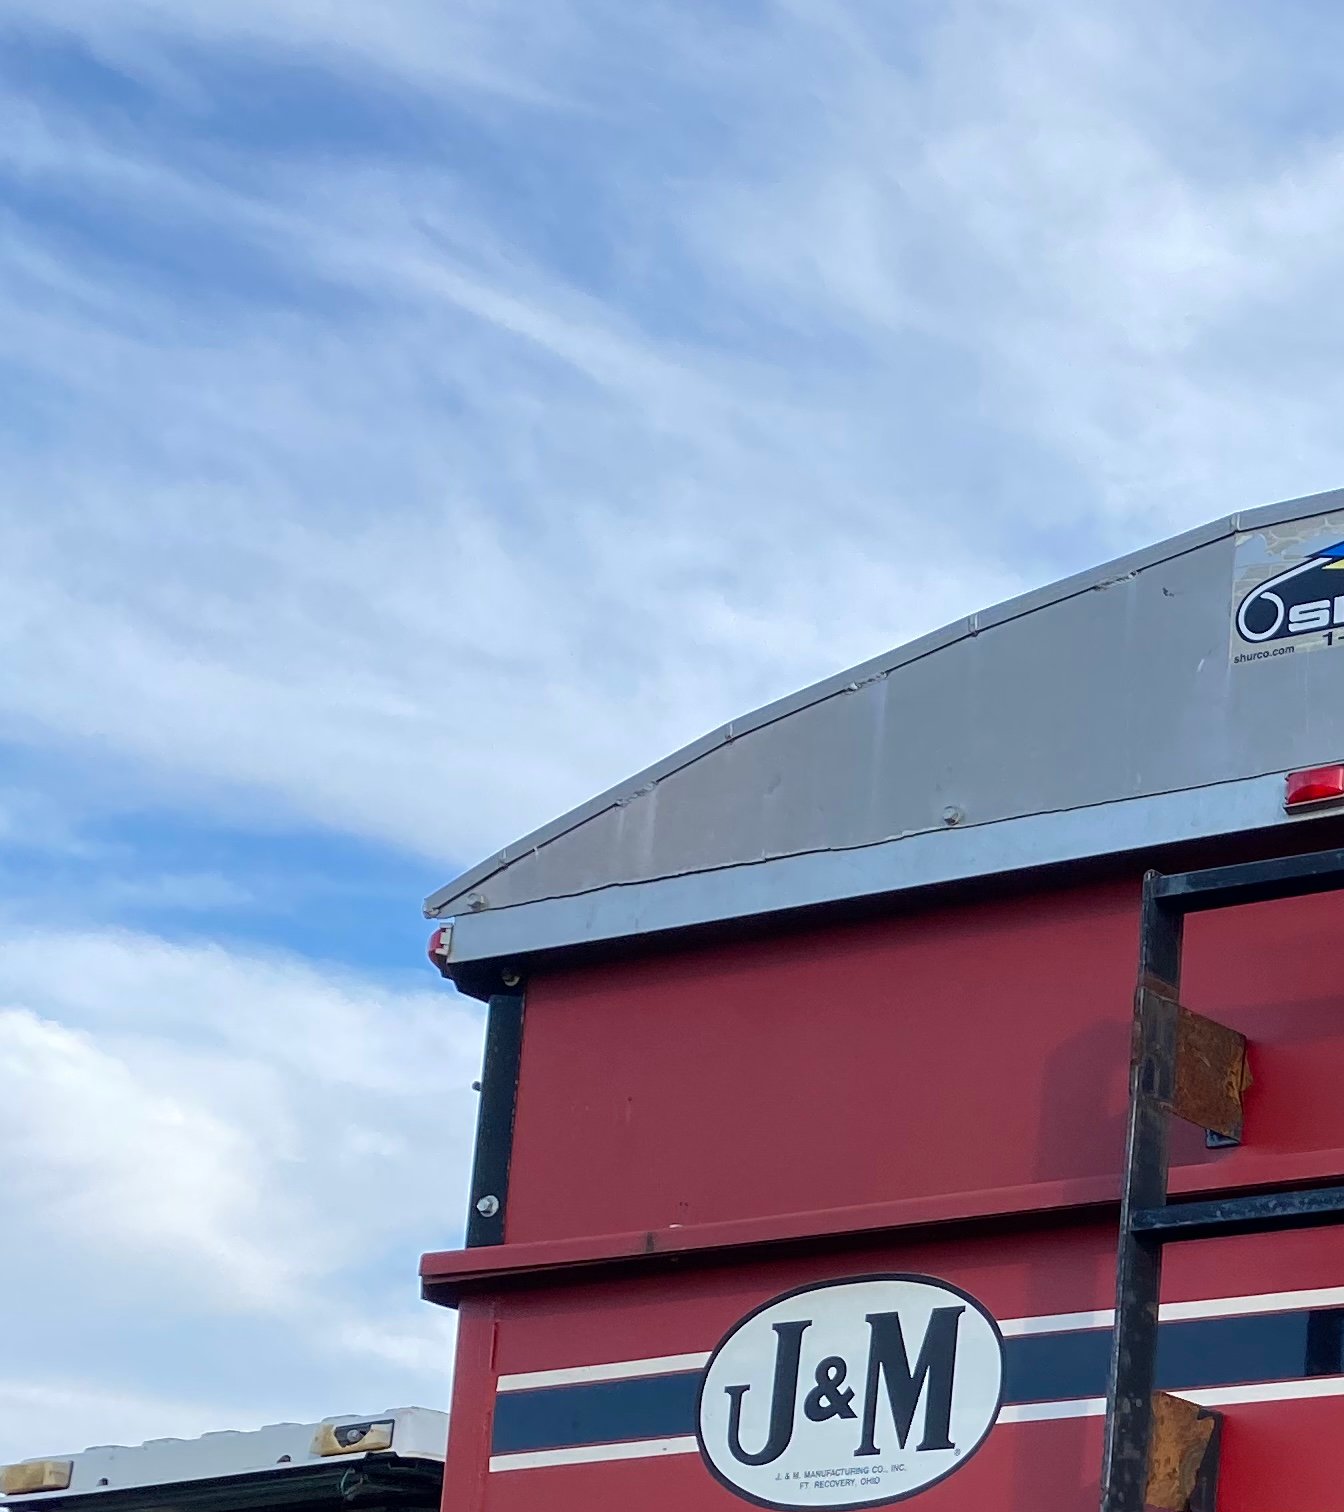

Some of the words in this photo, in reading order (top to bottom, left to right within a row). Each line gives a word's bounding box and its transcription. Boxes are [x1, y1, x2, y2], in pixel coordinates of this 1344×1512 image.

[1233, 645, 1295, 664] shurco.com
[724, 1305, 966, 1466] J&M
[784, 1472, 790, 1480] &
[804, 1467, 869, 1479] MANUFACTURING
[891, 1464, 907, 1472] INC.
[814, 1479, 857, 1489] RECOVERY,
[860, 1477, 881, 1486] OHIO
